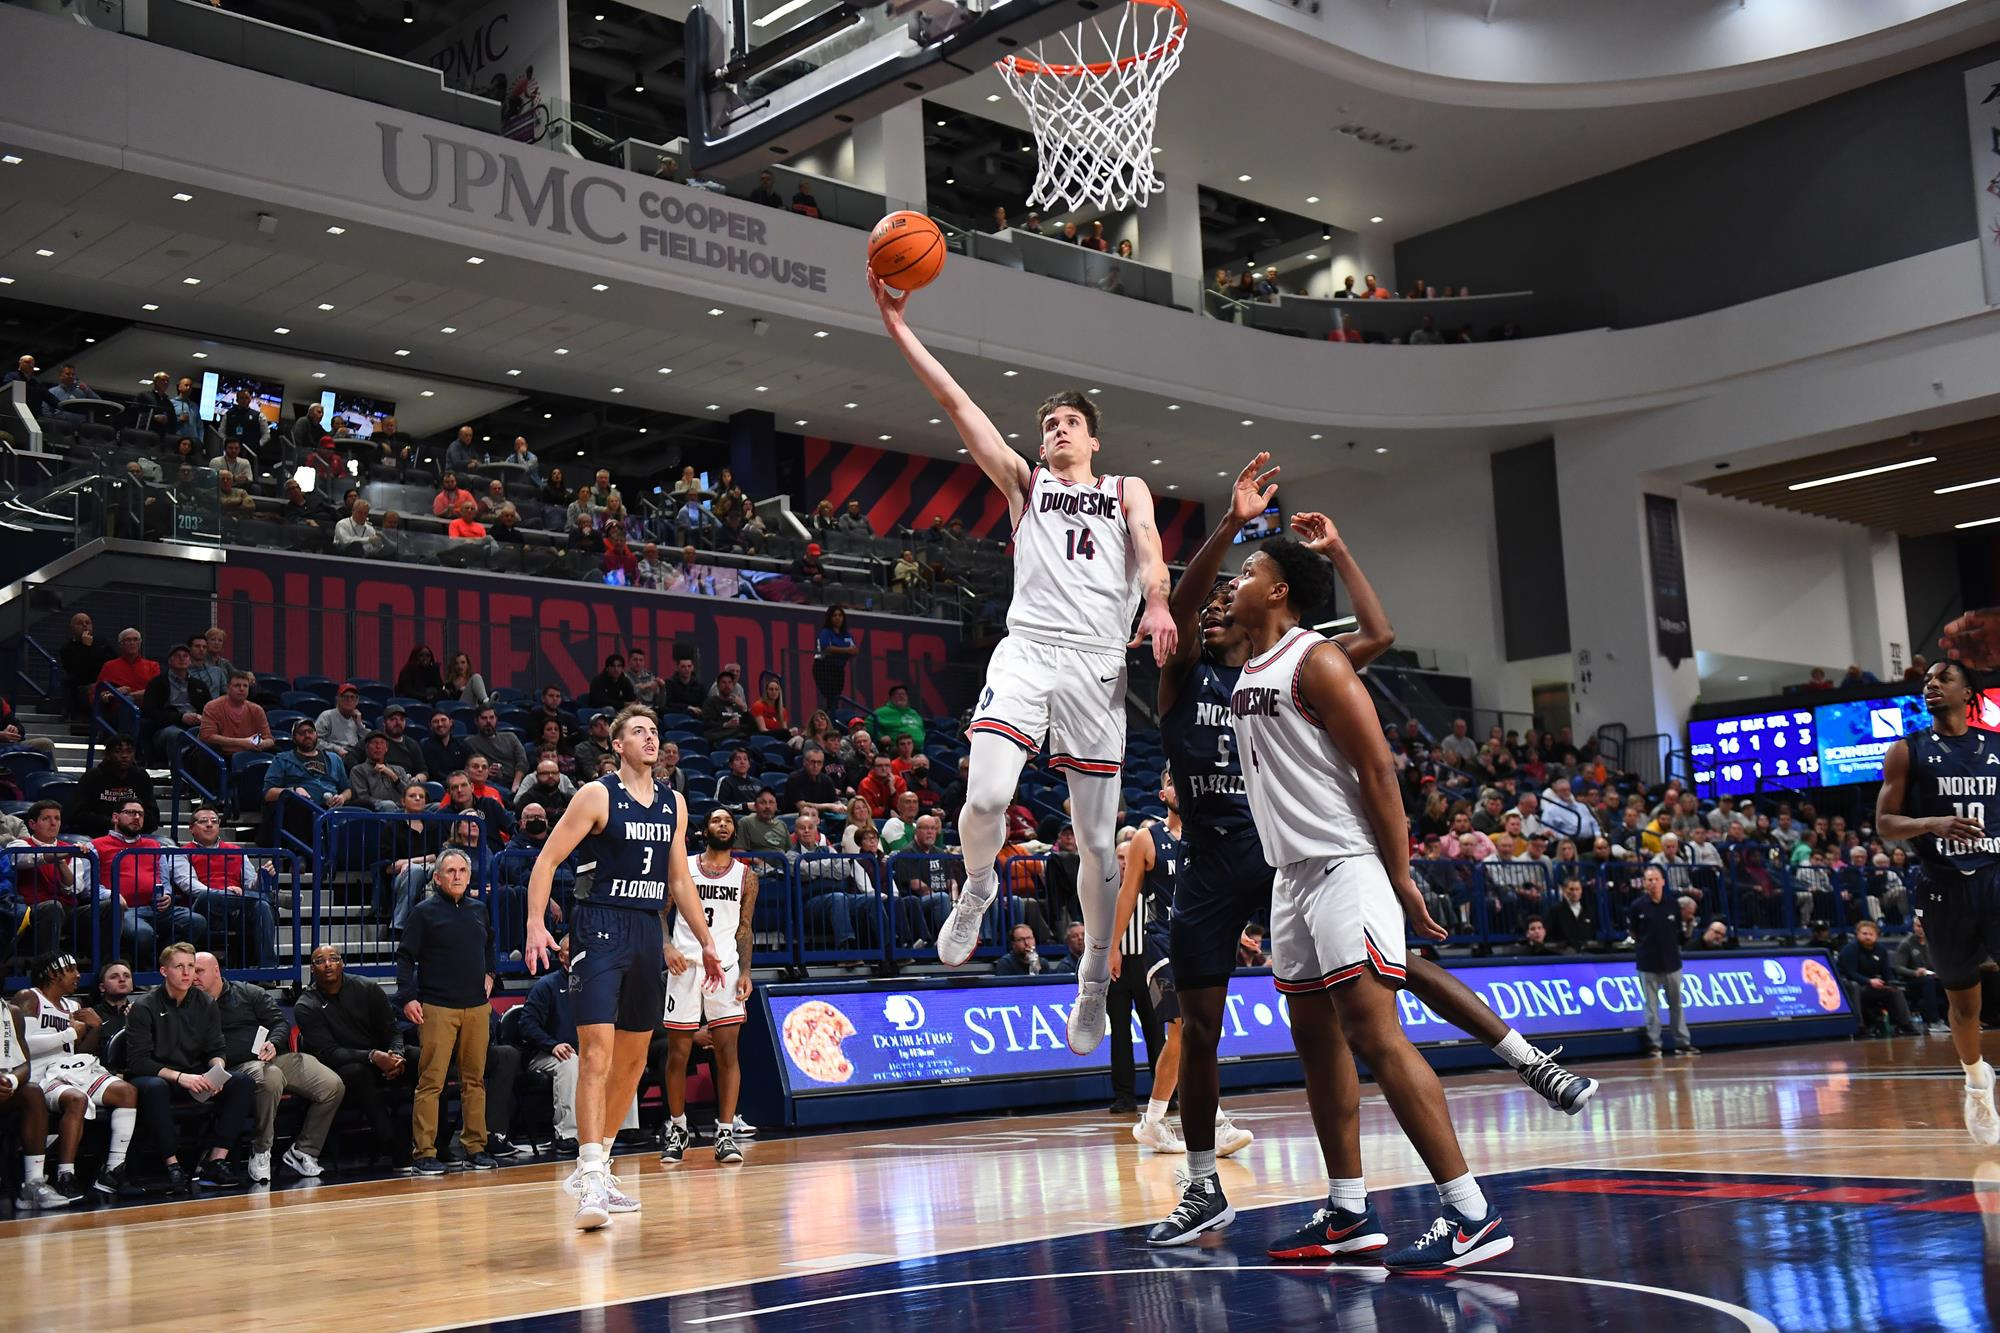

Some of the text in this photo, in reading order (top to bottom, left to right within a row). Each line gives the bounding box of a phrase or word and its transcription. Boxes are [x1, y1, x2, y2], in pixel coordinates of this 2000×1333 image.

[430, 13, 509, 83] PMC
[375, 121, 628, 245] UPMC
[639, 191, 767, 246] COOPER
[640, 225, 827, 293] FIELDHOUSE
[178, 514, 199, 530] 203
[1066, 528, 1095, 561] 14
[217, 566, 695, 700] DUQUESNE
[1214, 734, 1230, 768] 5
[1718, 737, 1740, 754] 16
[1749, 735, 1760, 750] 1
[1773, 731, 1786, 748] 6
[1798, 728, 1811, 745] 3
[1721, 764, 1743, 781] 10
[1752, 762, 1761, 778] 1
[1775, 759, 1789, 776] 2
[1796, 756, 1819, 774] 13
[1937, 776, 1997, 796] NORTH
[625, 821, 671, 842] NORTH
[641, 846, 654, 875] 3
[609, 878, 666, 900] FLORIDA
[704, 907, 714, 927] 3
[1489, 978, 1581, 1019] DINE
